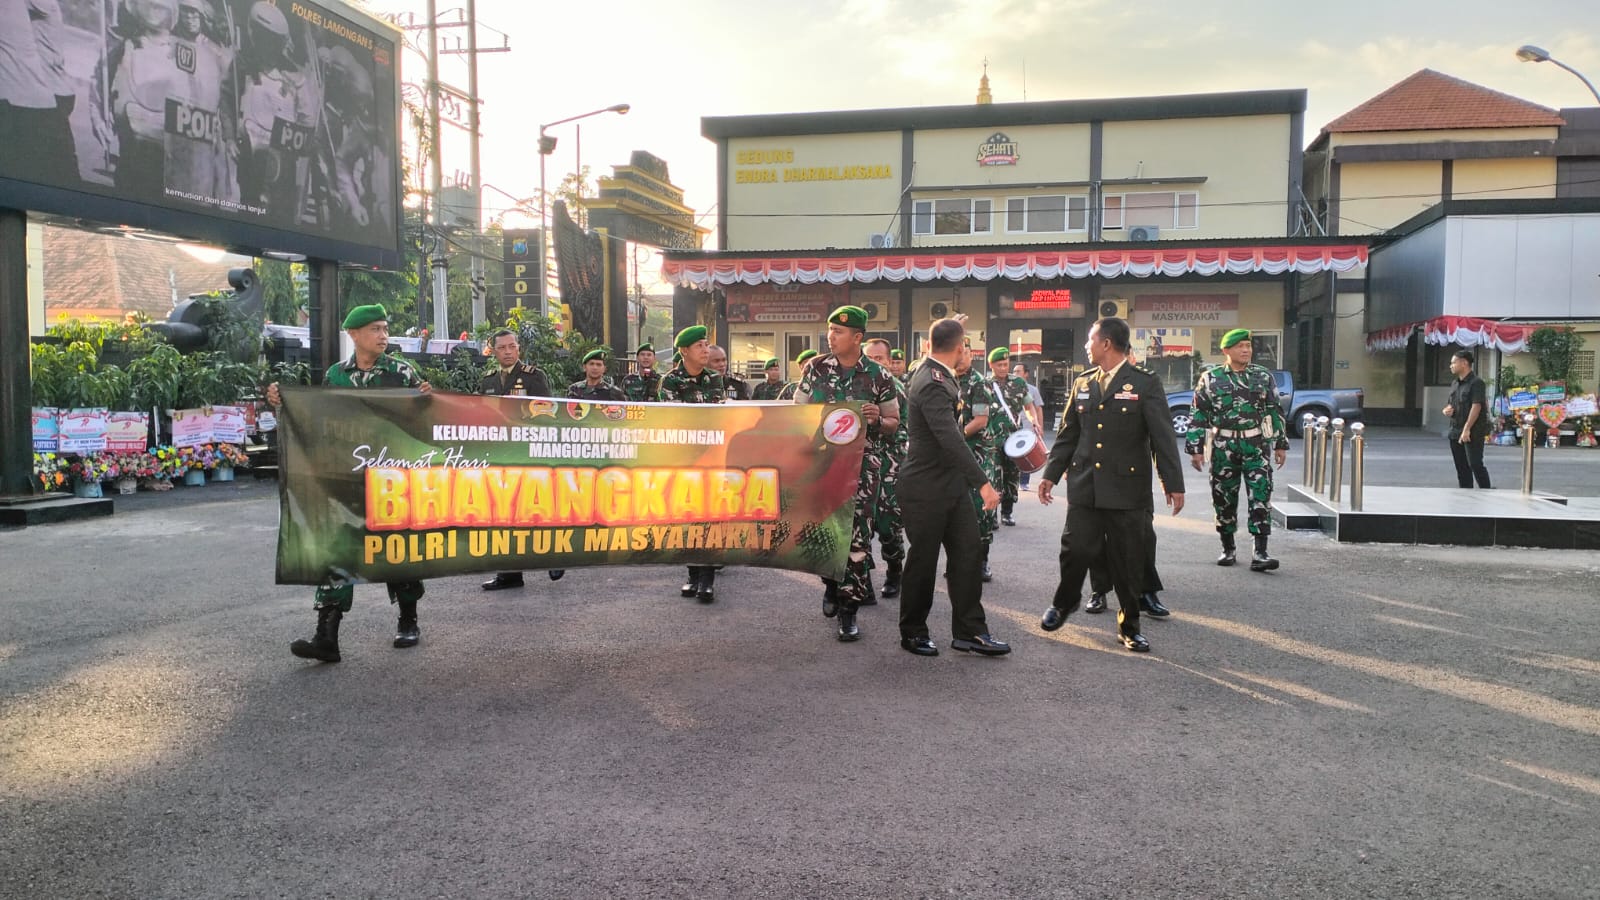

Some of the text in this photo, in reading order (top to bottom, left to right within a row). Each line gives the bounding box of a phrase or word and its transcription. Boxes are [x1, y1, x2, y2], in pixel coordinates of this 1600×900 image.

[292, 3, 321, 26] POLRES
[323, 18, 368, 48] LAMONGAN
[735, 149, 794, 164] GEDUNG
[977, 142, 1019, 161] SEHATI
[735, 165, 892, 183] ENDRA DHARMALAKSANA
[1152, 302, 1221, 311] POLRI UNTUK
[1151, 312, 1221, 321] MASYARAKAT
[432, 424, 508, 441] KELUARGA
[511, 426, 558, 442] BESAR
[561, 427, 608, 443] KODIM
[352, 444, 491, 471] Selamat Hari
[366, 467, 779, 529] BHAYANGKARA
[364, 523, 776, 564] POLRI UNTUK MASYARAKAT
